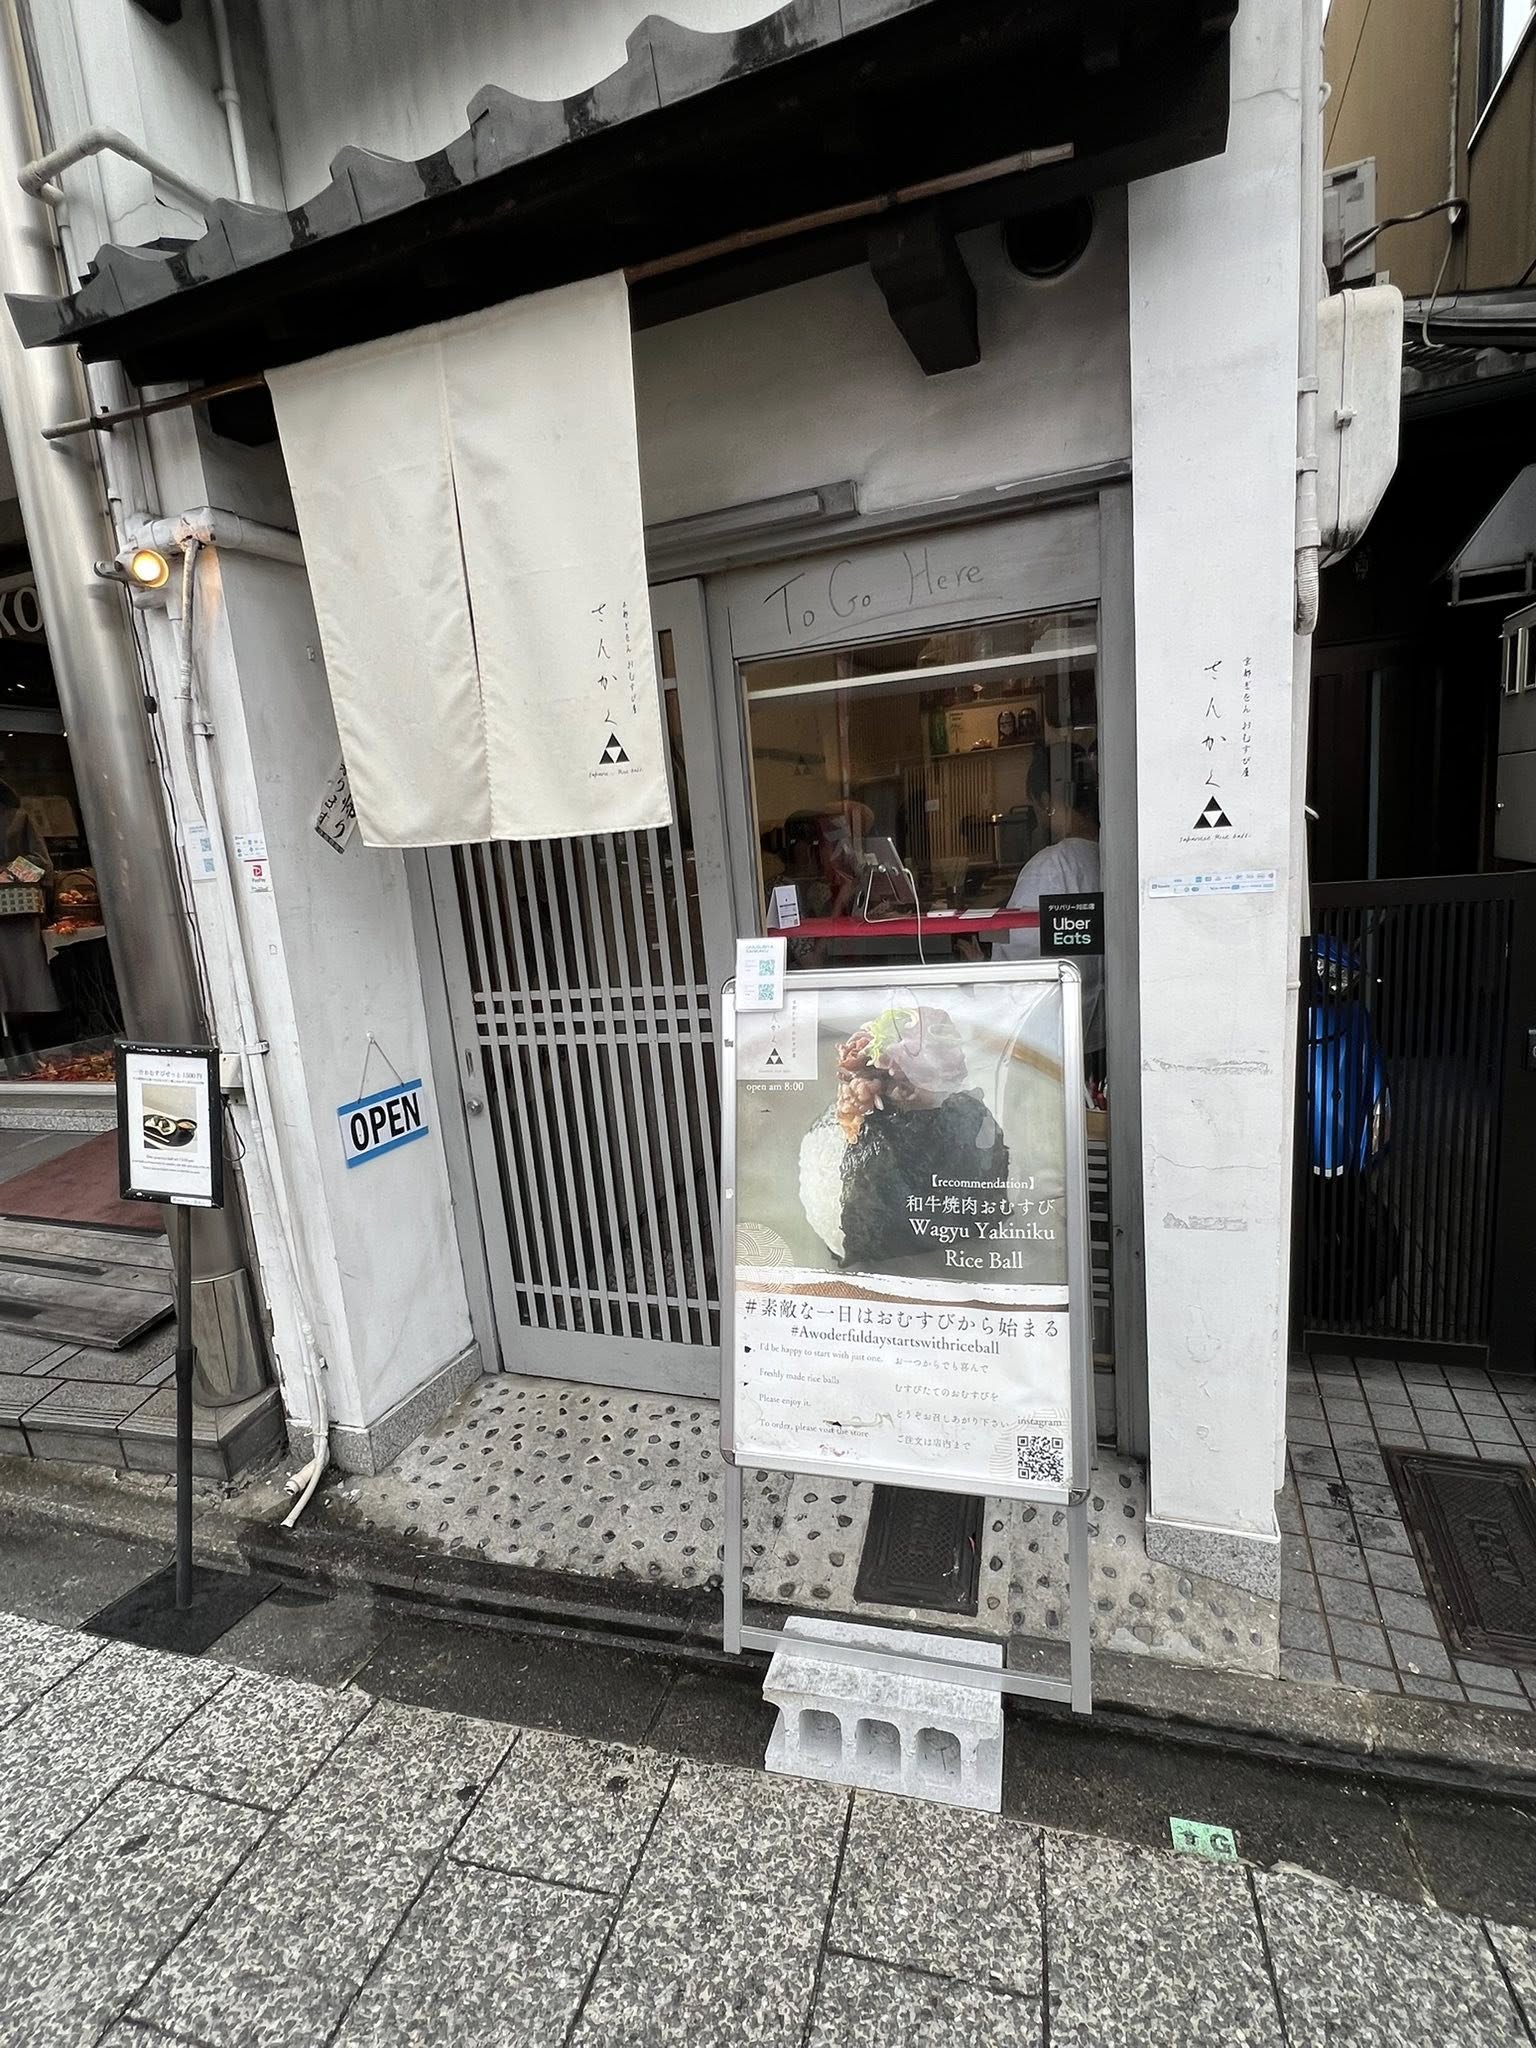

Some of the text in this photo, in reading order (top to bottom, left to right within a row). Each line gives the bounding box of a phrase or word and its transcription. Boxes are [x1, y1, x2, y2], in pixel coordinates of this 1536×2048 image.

[762, 547, 984, 634] To Go Here
[591, 603, 618, 726] さんかく
[1201, 660, 1227, 788] さんかく
[1053, 917, 1091, 931] Uber
[1053, 932, 1091, 945] Eats
[746, 1084, 767, 1094] open
[784, 1081, 804, 1092] 8:00
[350, 1092, 421, 1151] OPEN
[906, 1195, 1056, 1216] 和牛焼肉おむすび
[909, 1218, 1056, 1243] Wagyu Yakiniku
[945, 1249, 1024, 1269] Rice Ball
[744, 1298, 1060, 1338] #素敵な一日はおむすびから始まる
[791, 1325, 1001, 1355] #Awoderfuldaystartswithriceball
[771, 1344, 780, 1352] be
[781, 1345, 802, 1357] happy
[814, 1350, 831, 1358] start
[832, 1351, 850, 1359] with
[851, 1353, 865, 1362] just
[759, 1368, 840, 1384] Freshly made rice balls
[759, 1393, 780, 1403] Please
[781, 1397, 802, 1408] enjoy
[895, 1384, 999, 1402] むすびたてのおむすびを
[795, 1422, 817, 1432] please
[836, 1427, 849, 1435] the
[1017, 1415, 1063, 1428] instagram
